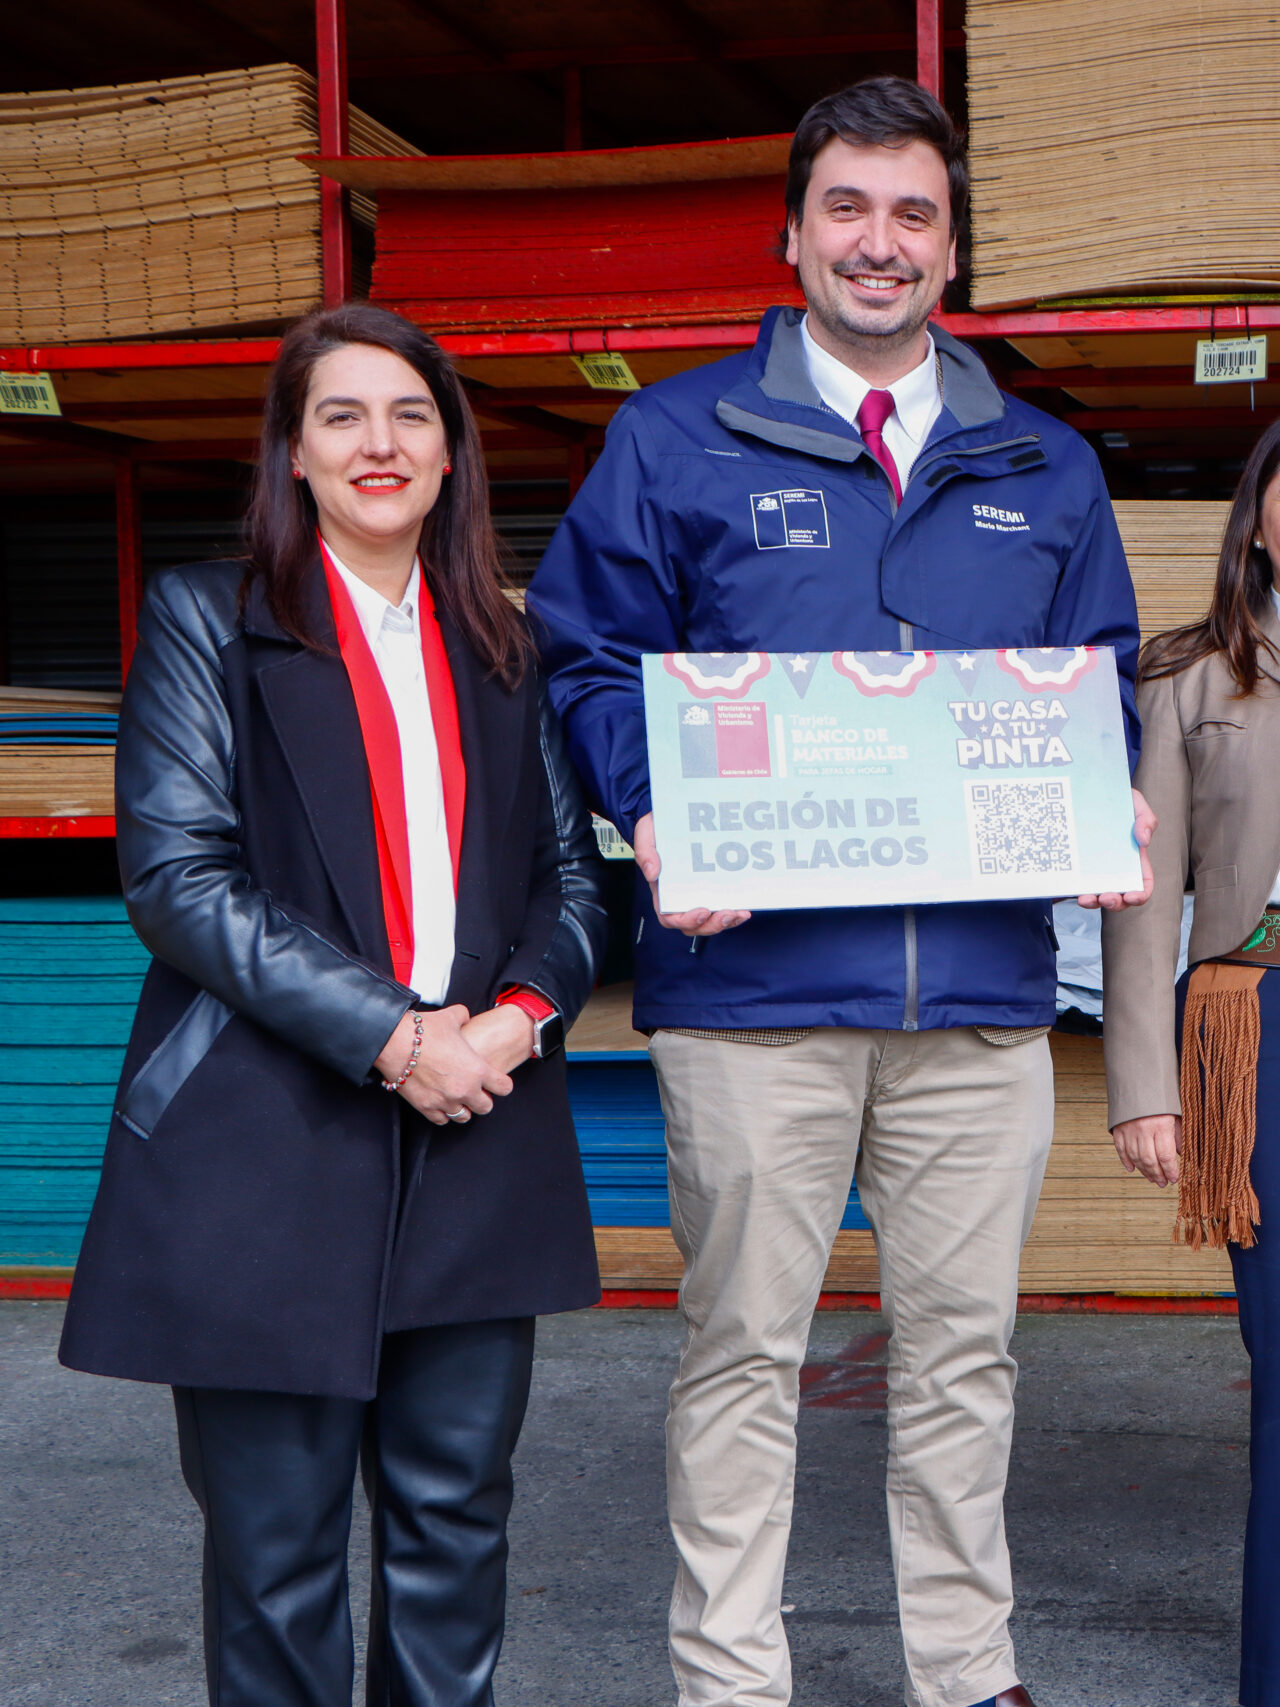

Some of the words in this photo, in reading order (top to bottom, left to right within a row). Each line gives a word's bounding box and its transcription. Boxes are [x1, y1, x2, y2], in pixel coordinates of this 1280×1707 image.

[1204, 367, 1240, 377] 202724
[973, 504, 1025, 523] SEREMI
[975, 520, 995, 530] Mario
[996, 524, 1030, 532] Marchant
[948, 702, 986, 721] TU
[991, 699, 1069, 720] CASA
[789, 714, 837, 728] Tarjeta
[990, 722, 1006, 736] A
[1009, 721, 1036, 736] TU
[791, 728, 859, 744] BANCO
[863, 728, 889, 742] DE
[792, 745, 909, 762] MATERIALES
[957, 736, 1073, 765] PINTA
[798, 767, 819, 775] PARA
[845, 767, 856, 775] DE
[858, 766, 887, 775] HOGAR
[687, 791, 856, 832] REGIÓN
[865, 797, 920, 827] DE
[691, 840, 776, 873] LOS
[784, 836, 929, 870] LAGOS
